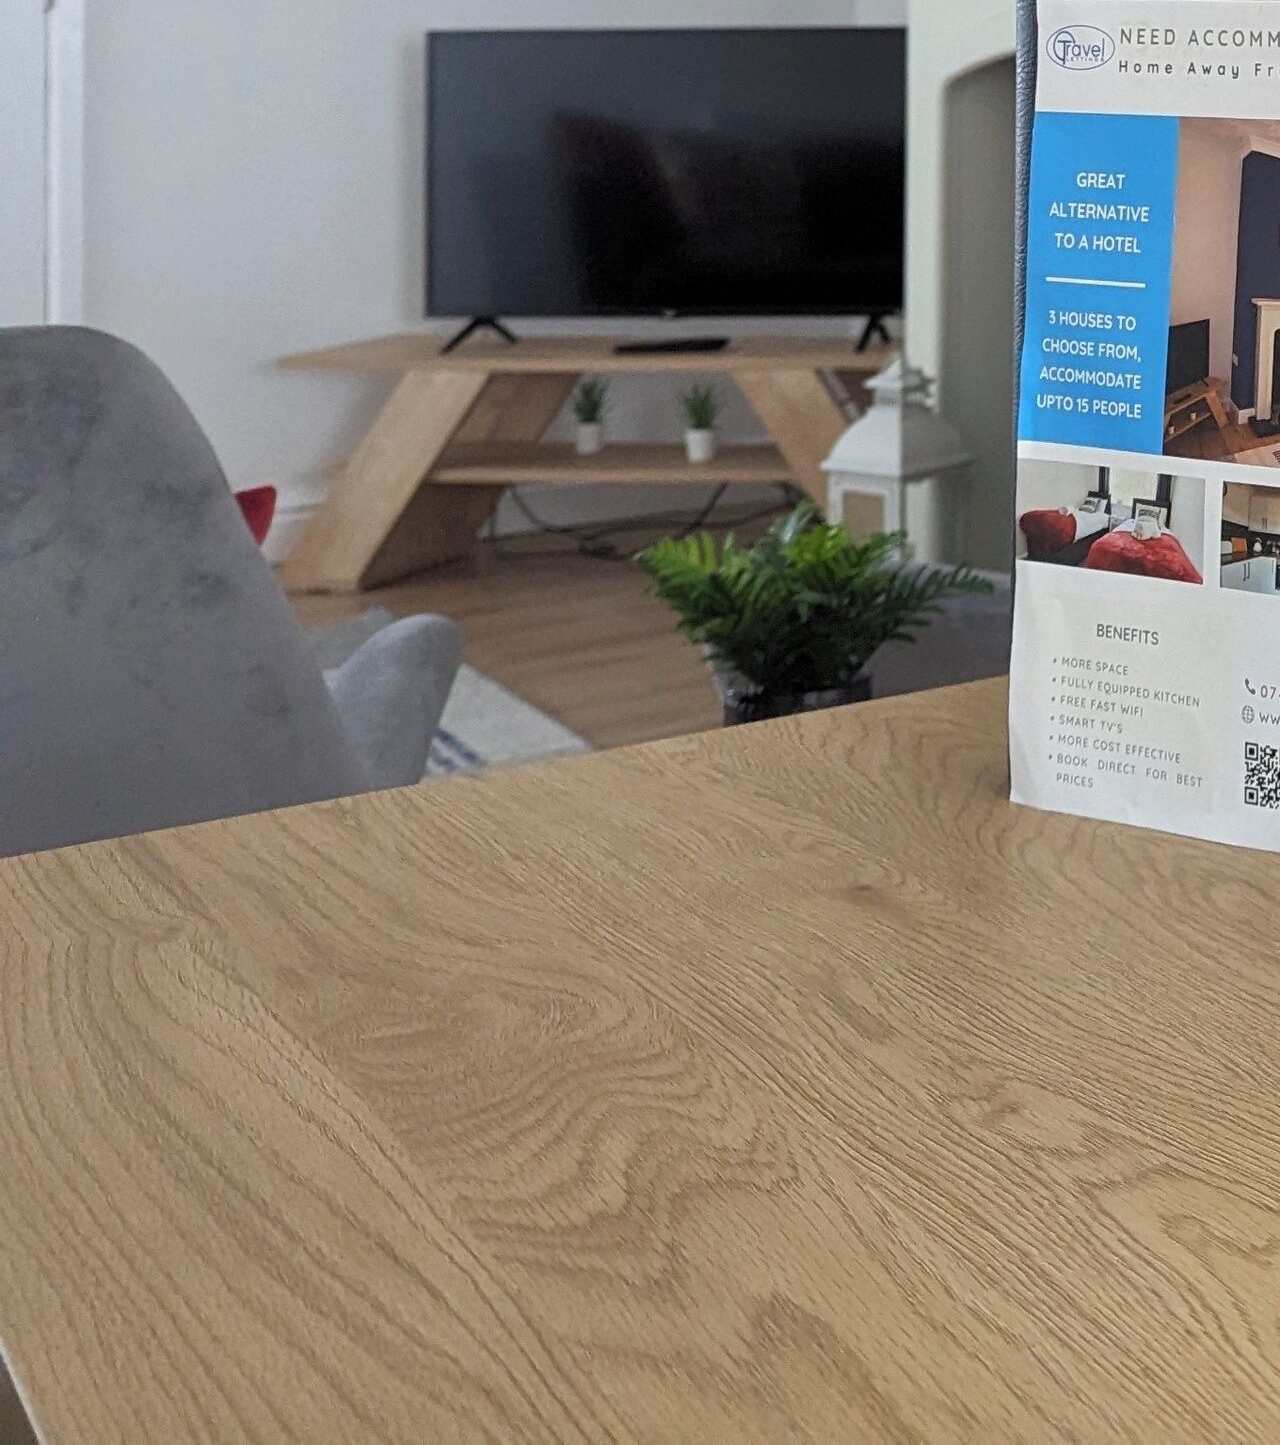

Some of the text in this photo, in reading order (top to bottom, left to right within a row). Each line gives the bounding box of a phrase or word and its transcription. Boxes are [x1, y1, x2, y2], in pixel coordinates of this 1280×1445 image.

[1053, 31, 1105, 64] Travel
[1120, 28, 1176, 46] NEED
[1119, 60, 1173, 74] Home
[1187, 63, 1240, 79] Away
[1077, 172, 1126, 190] GREAT
[1050, 202, 1149, 222] ALTERNATIVE
[1055, 233, 1141, 253] TO A HOTEL
[1049, 310, 1136, 331] 3 HOUSES TO
[1043, 338, 1141, 363] CHOOSE FROM,
[1040, 366, 1141, 390] ACCOMMODATE
[1037, 395, 1142, 418] UPTO 15 PEOPLE
[1097, 624, 1159, 645] BENEFITS
[1061, 657, 1128, 675] MORE SPACE
[1061, 676, 1200, 706] FULLY EQUIPPED KITCHEN
[1060, 695, 1143, 717] FREE FAST WIFI
[1059, 715, 1123, 733] SMART TV'S
[1058, 735, 1182, 764] MORE COST EFFECTIVE
[1056, 773, 1094, 788] PRICES
[1057, 753, 1203, 788] BOOK DIRECT FOR BEST
